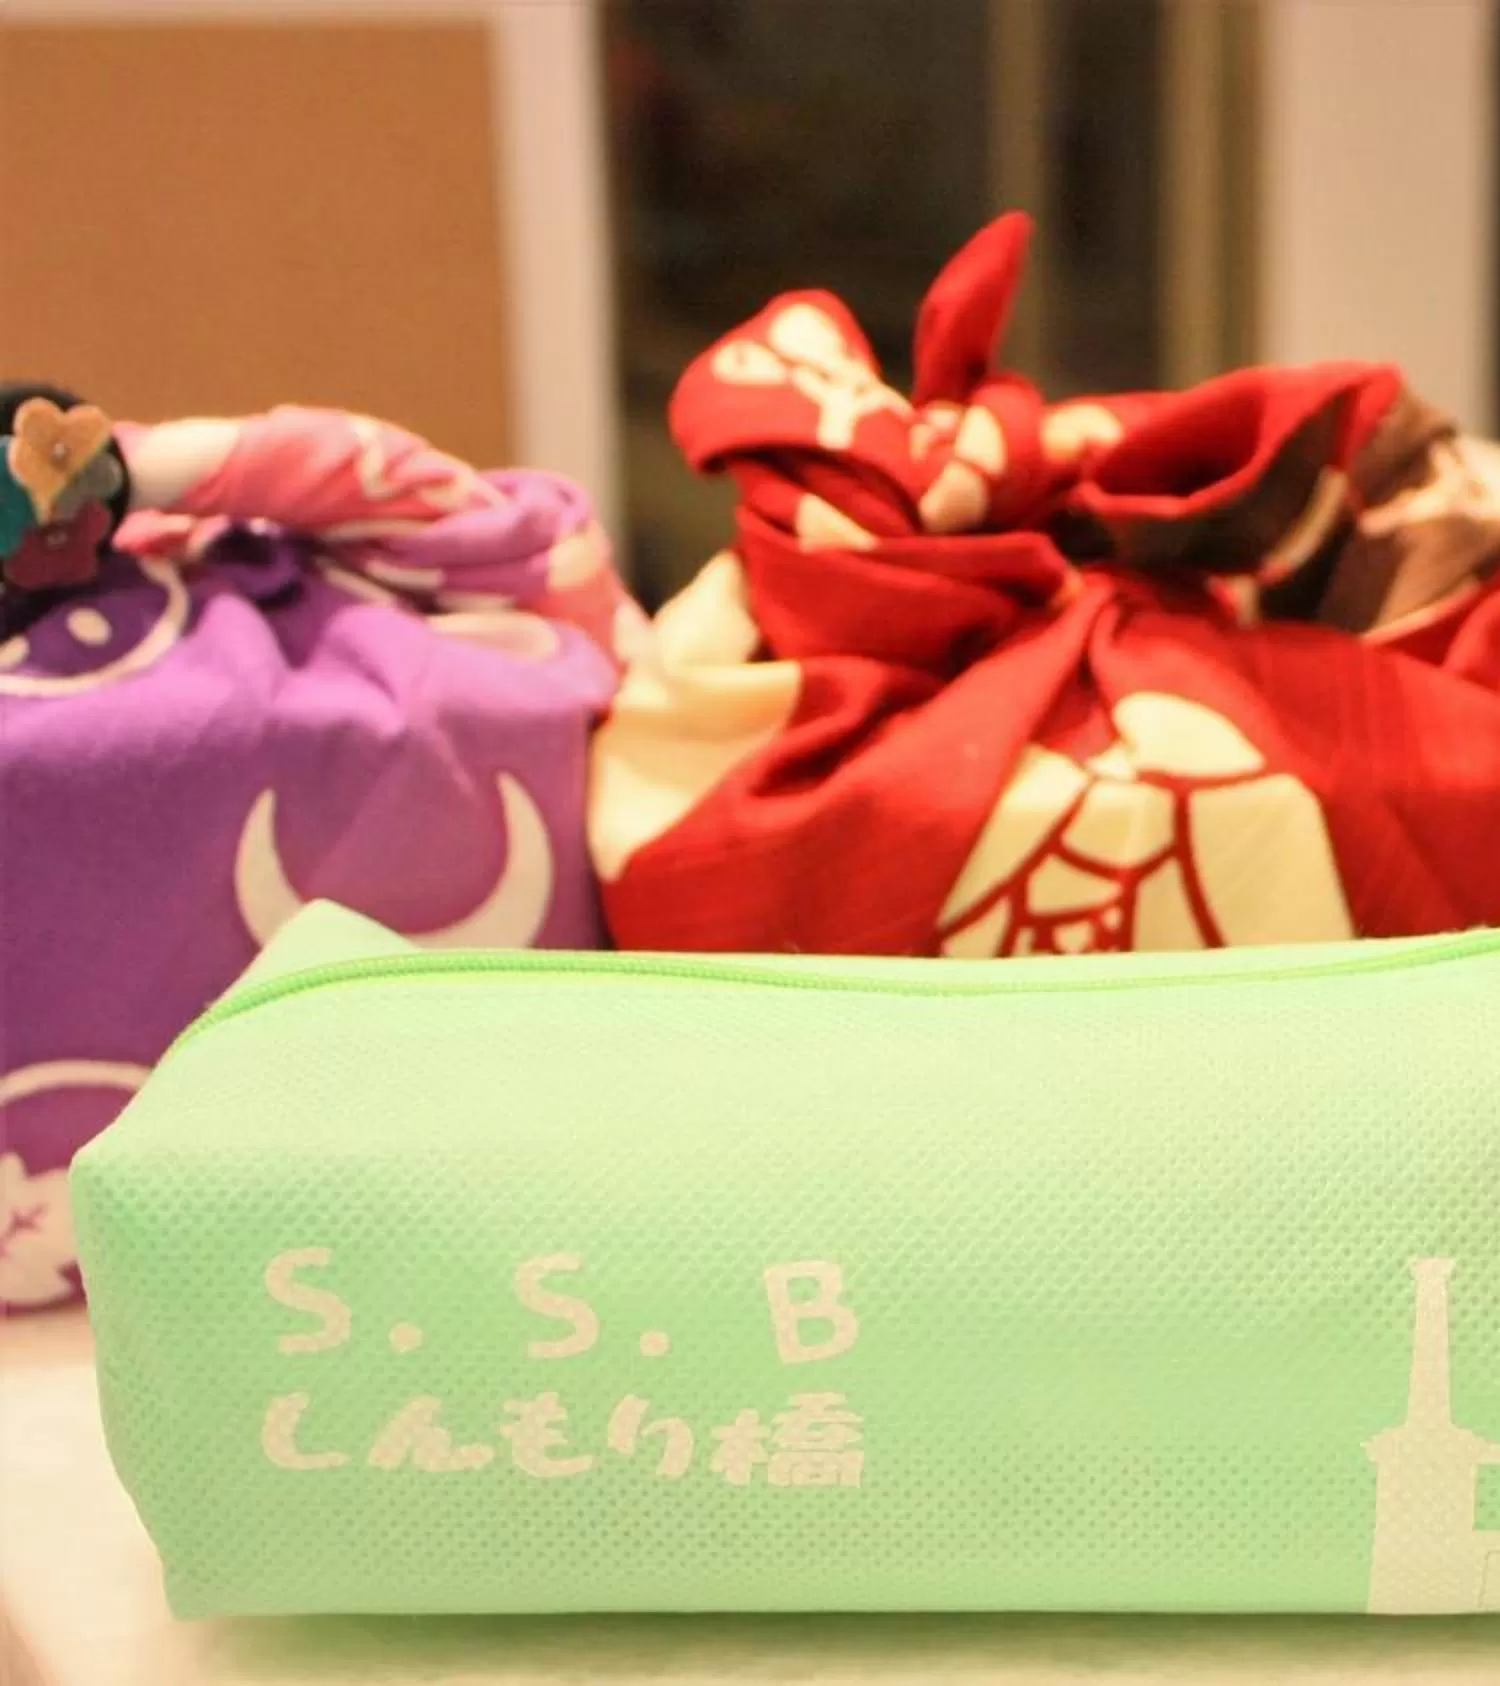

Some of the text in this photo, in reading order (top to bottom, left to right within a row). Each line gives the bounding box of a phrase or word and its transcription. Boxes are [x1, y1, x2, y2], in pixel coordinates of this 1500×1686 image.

[261, 1391, 865, 1488] しんもり橋
